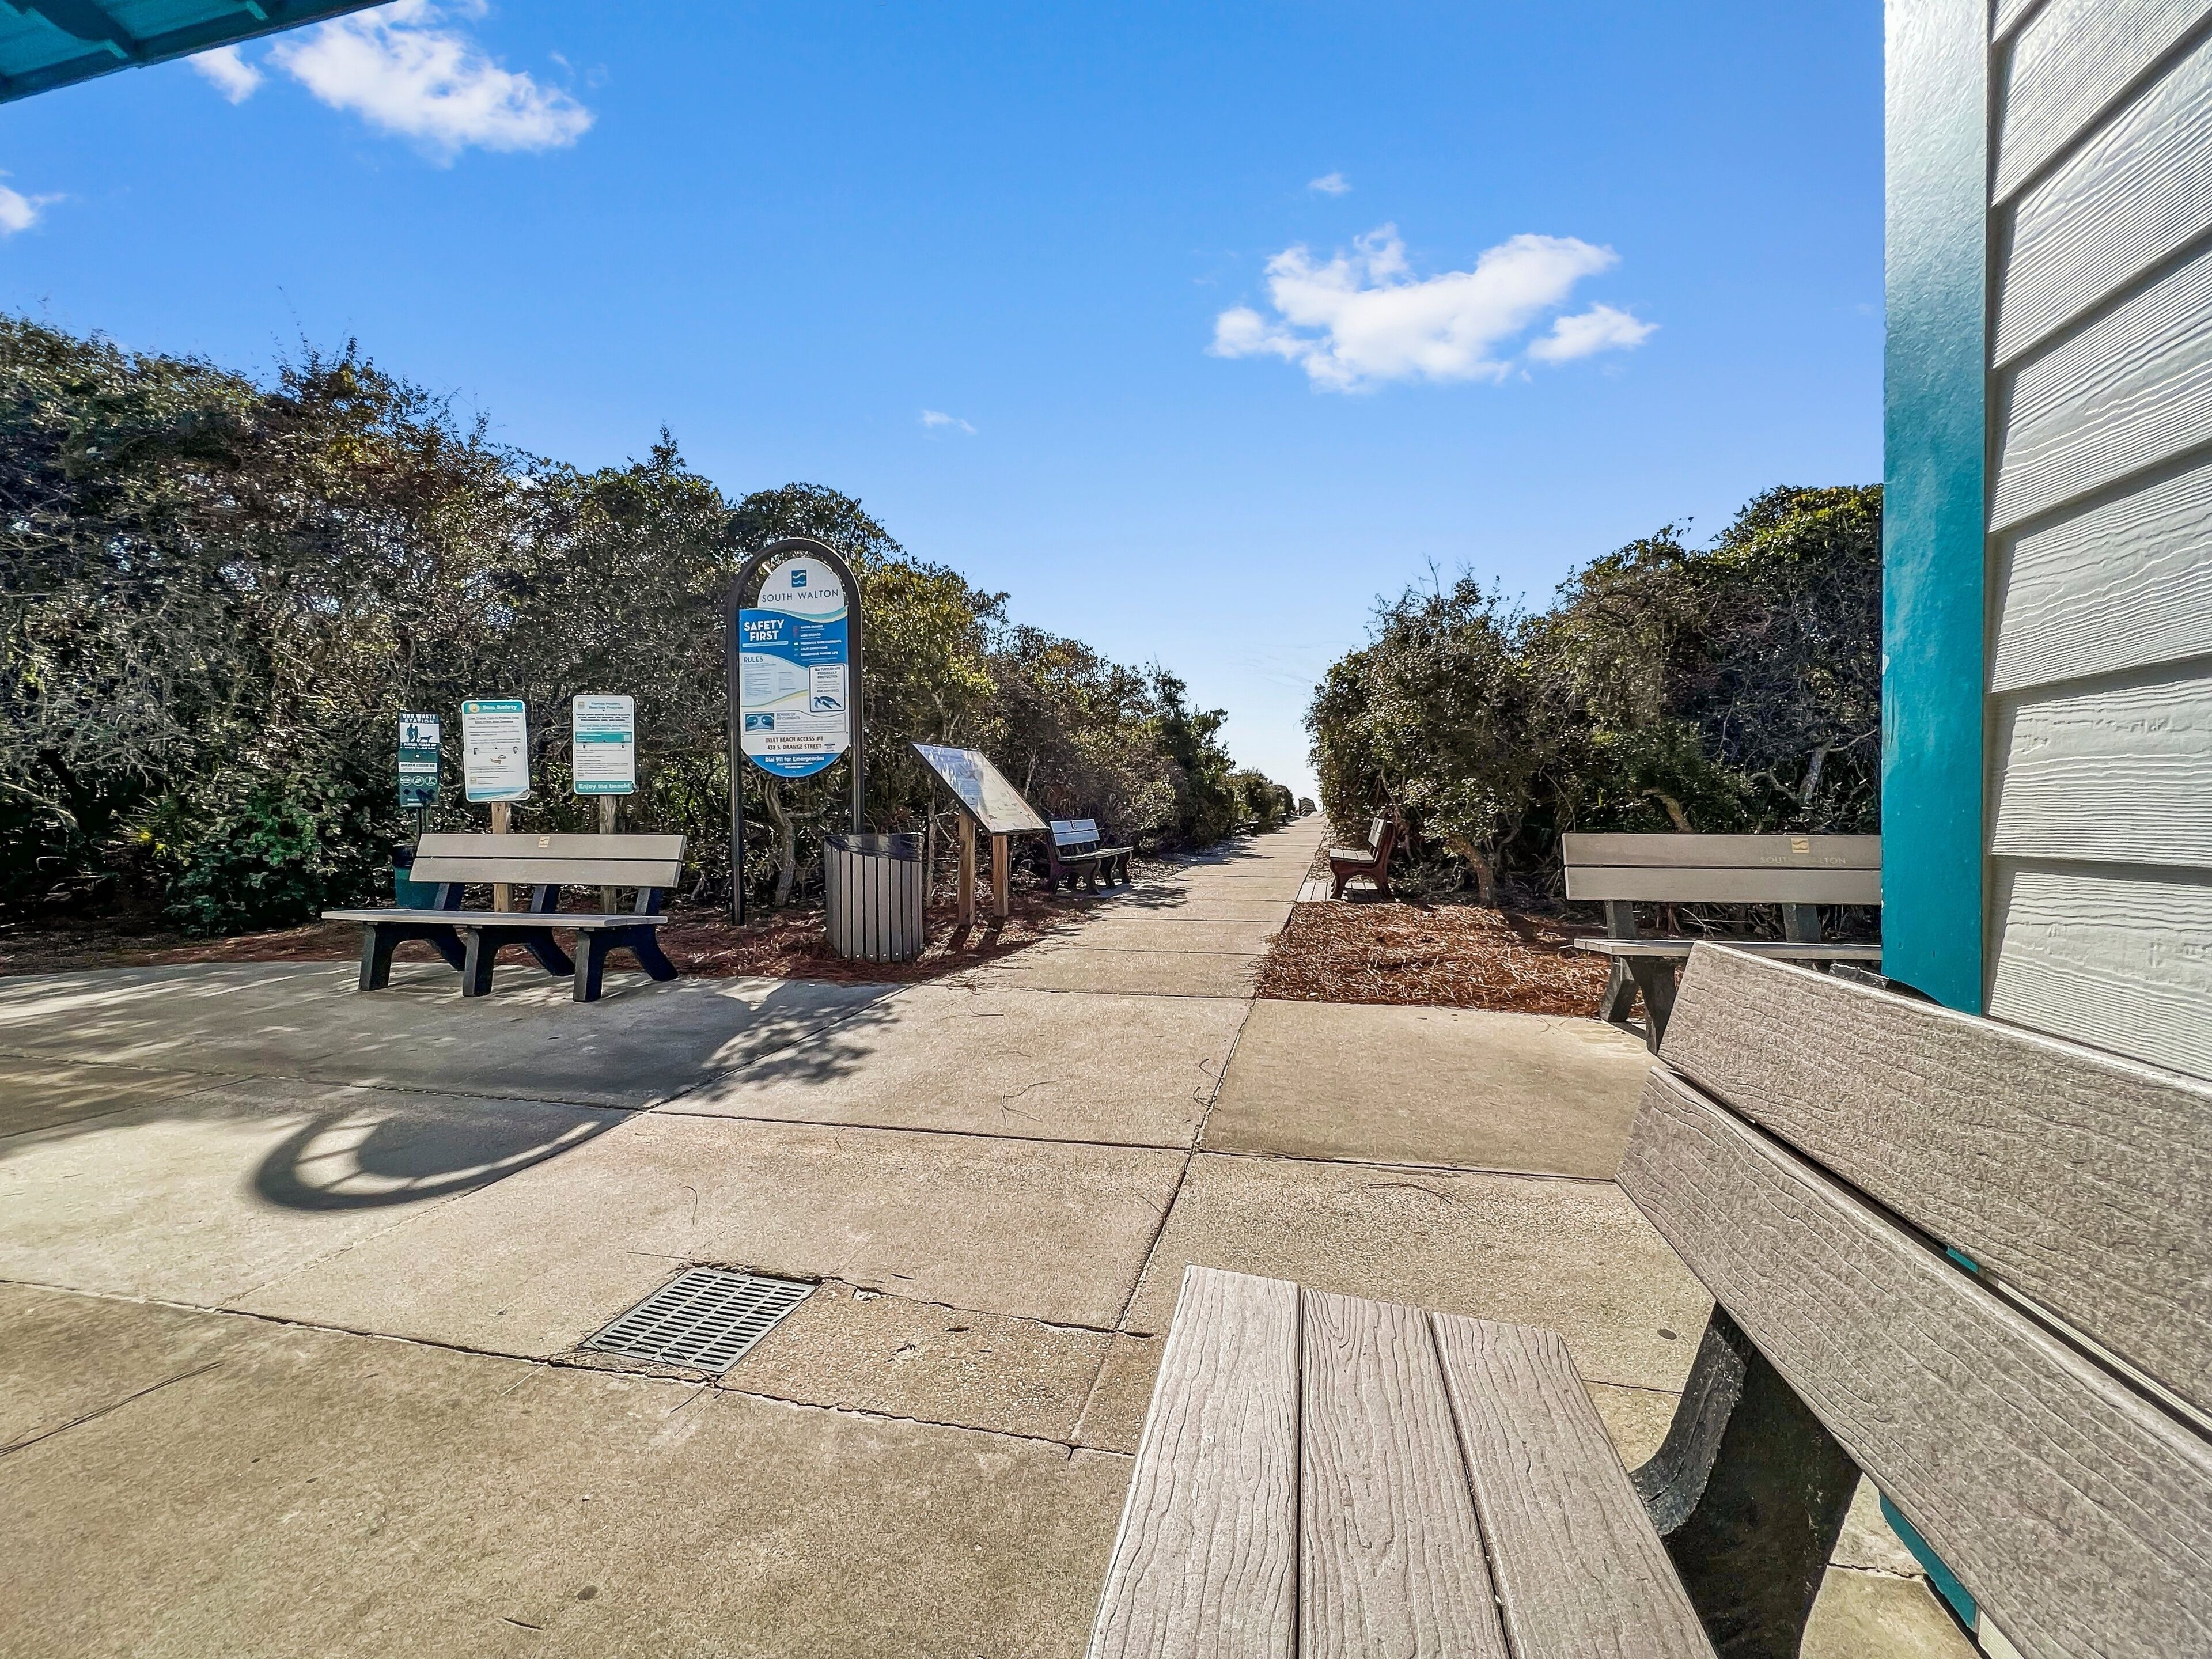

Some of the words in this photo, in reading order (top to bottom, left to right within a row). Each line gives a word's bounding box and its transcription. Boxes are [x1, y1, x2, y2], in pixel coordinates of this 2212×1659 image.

[762, 593, 793, 603] SOUTH
[797, 589, 839, 600] WALTON
[744, 619, 785, 632] SAFETY
[749, 630, 779, 642] FIRST
[1760, 856, 1793, 864] SOUT
